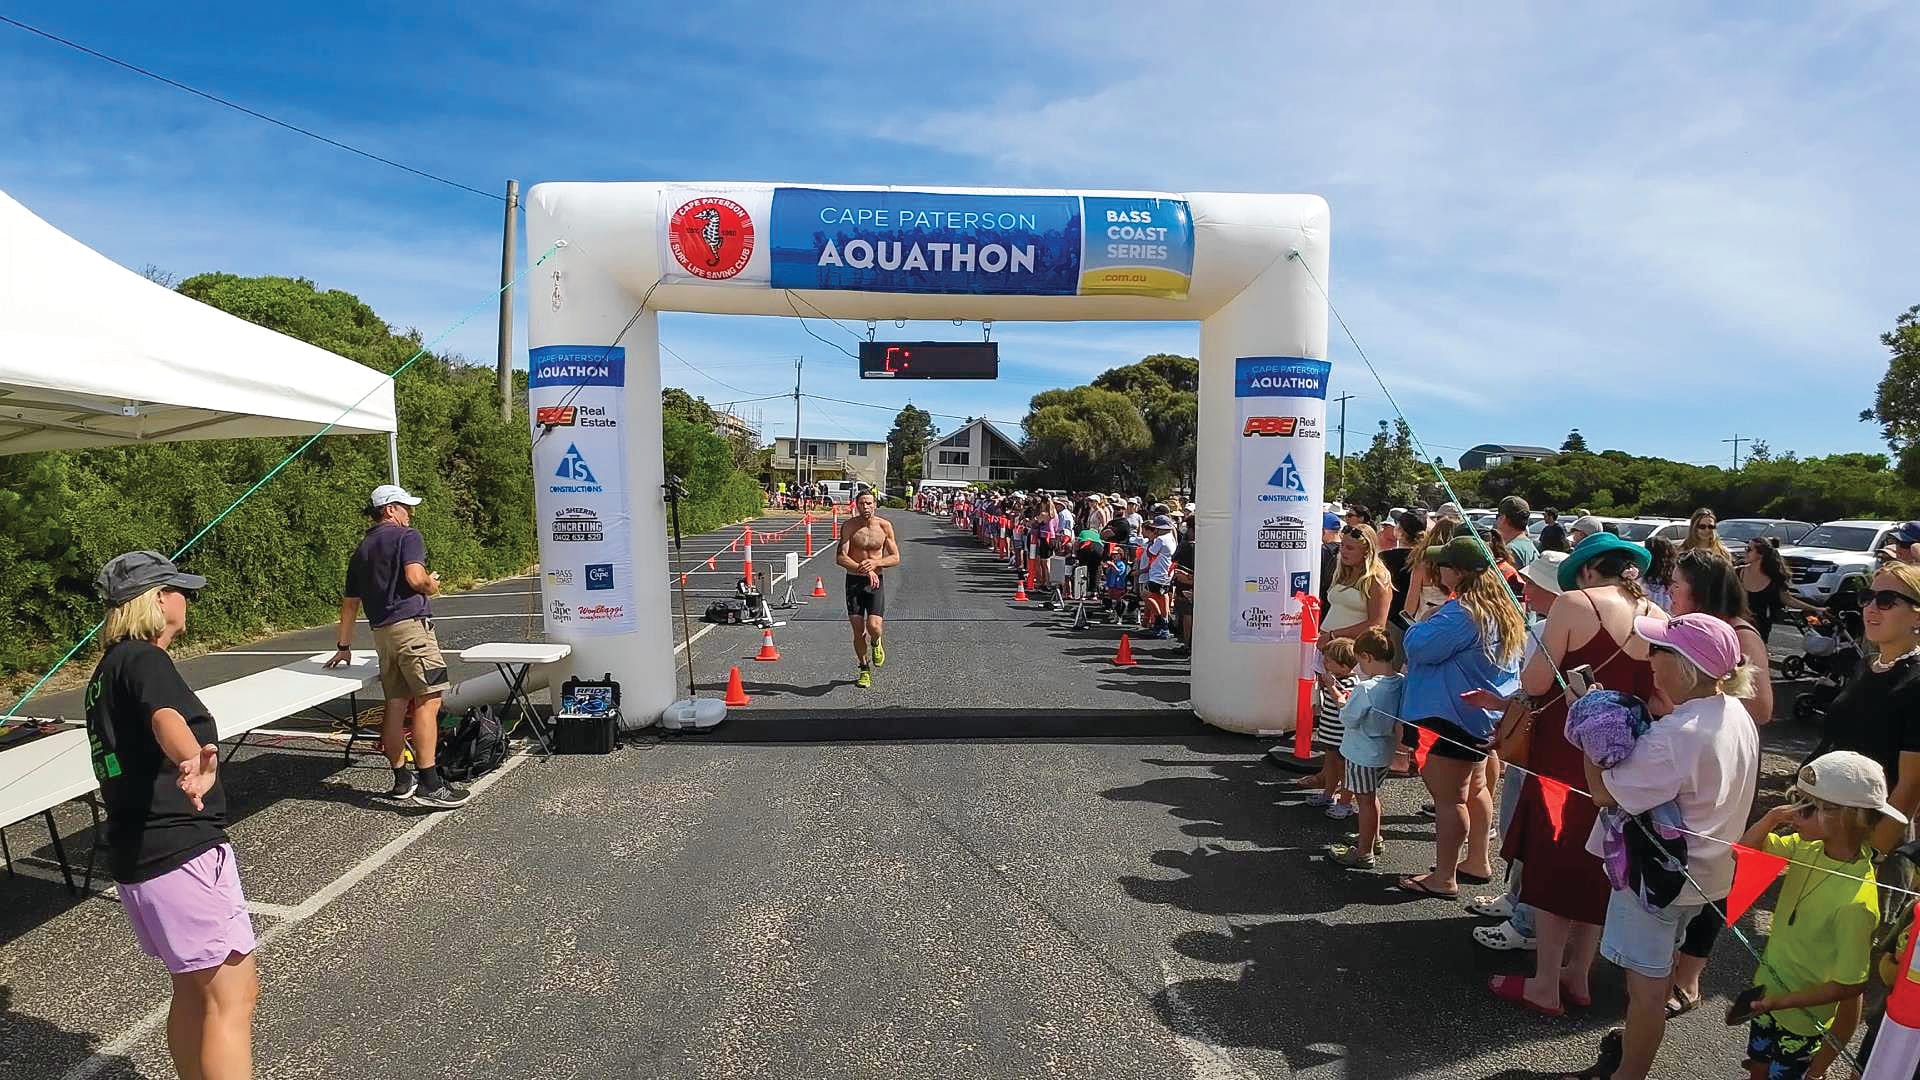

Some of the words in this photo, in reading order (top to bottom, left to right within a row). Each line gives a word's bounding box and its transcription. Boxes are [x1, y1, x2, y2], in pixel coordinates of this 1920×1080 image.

[679, 200, 701, 216] CAPE
[702, 198, 746, 217] PATERSON
[820, 207, 889, 227] CAPE
[899, 210, 1036, 230] PATERSON
[1106, 210, 1152, 224] BASS
[1107, 225, 1168, 241] COAST
[817, 238, 1036, 274] AQUATHON
[1107, 243, 1168, 260] SERIES
[672, 243, 689, 265] SURF
[687, 263, 705, 277] LIFE
[706, 267, 737, 279] SAVING
[735, 248, 751, 269] CLUB
[1102, 273, 1147, 282] .com.au
[538, 354, 556, 363] CAPE
[558, 353, 609, 363] PATERSON
[537, 365, 609, 379] AQUATHON
[1252, 365, 1279, 374] CAPE
[1280, 365, 1319, 375] PATERSON
[1250, 377, 1319, 390] AQUATHON
[580, 406, 606, 416] Real
[580, 417, 617, 428] Estate
[1299, 417, 1316, 427] Real
[1298, 428, 1321, 439] Estate
[565, 453, 589, 481] TS
[1281, 463, 1300, 490] TS
[549, 485, 603, 493] CONSTRUCTIONS
[1257, 494, 1309, 502] CONSTRUCTIONS
[552, 521, 602, 532] CONCRETING
[1258, 530, 1307, 541] CONCRETING
[555, 569, 573, 577] BASS
[1258, 577, 1279, 585] BASS
